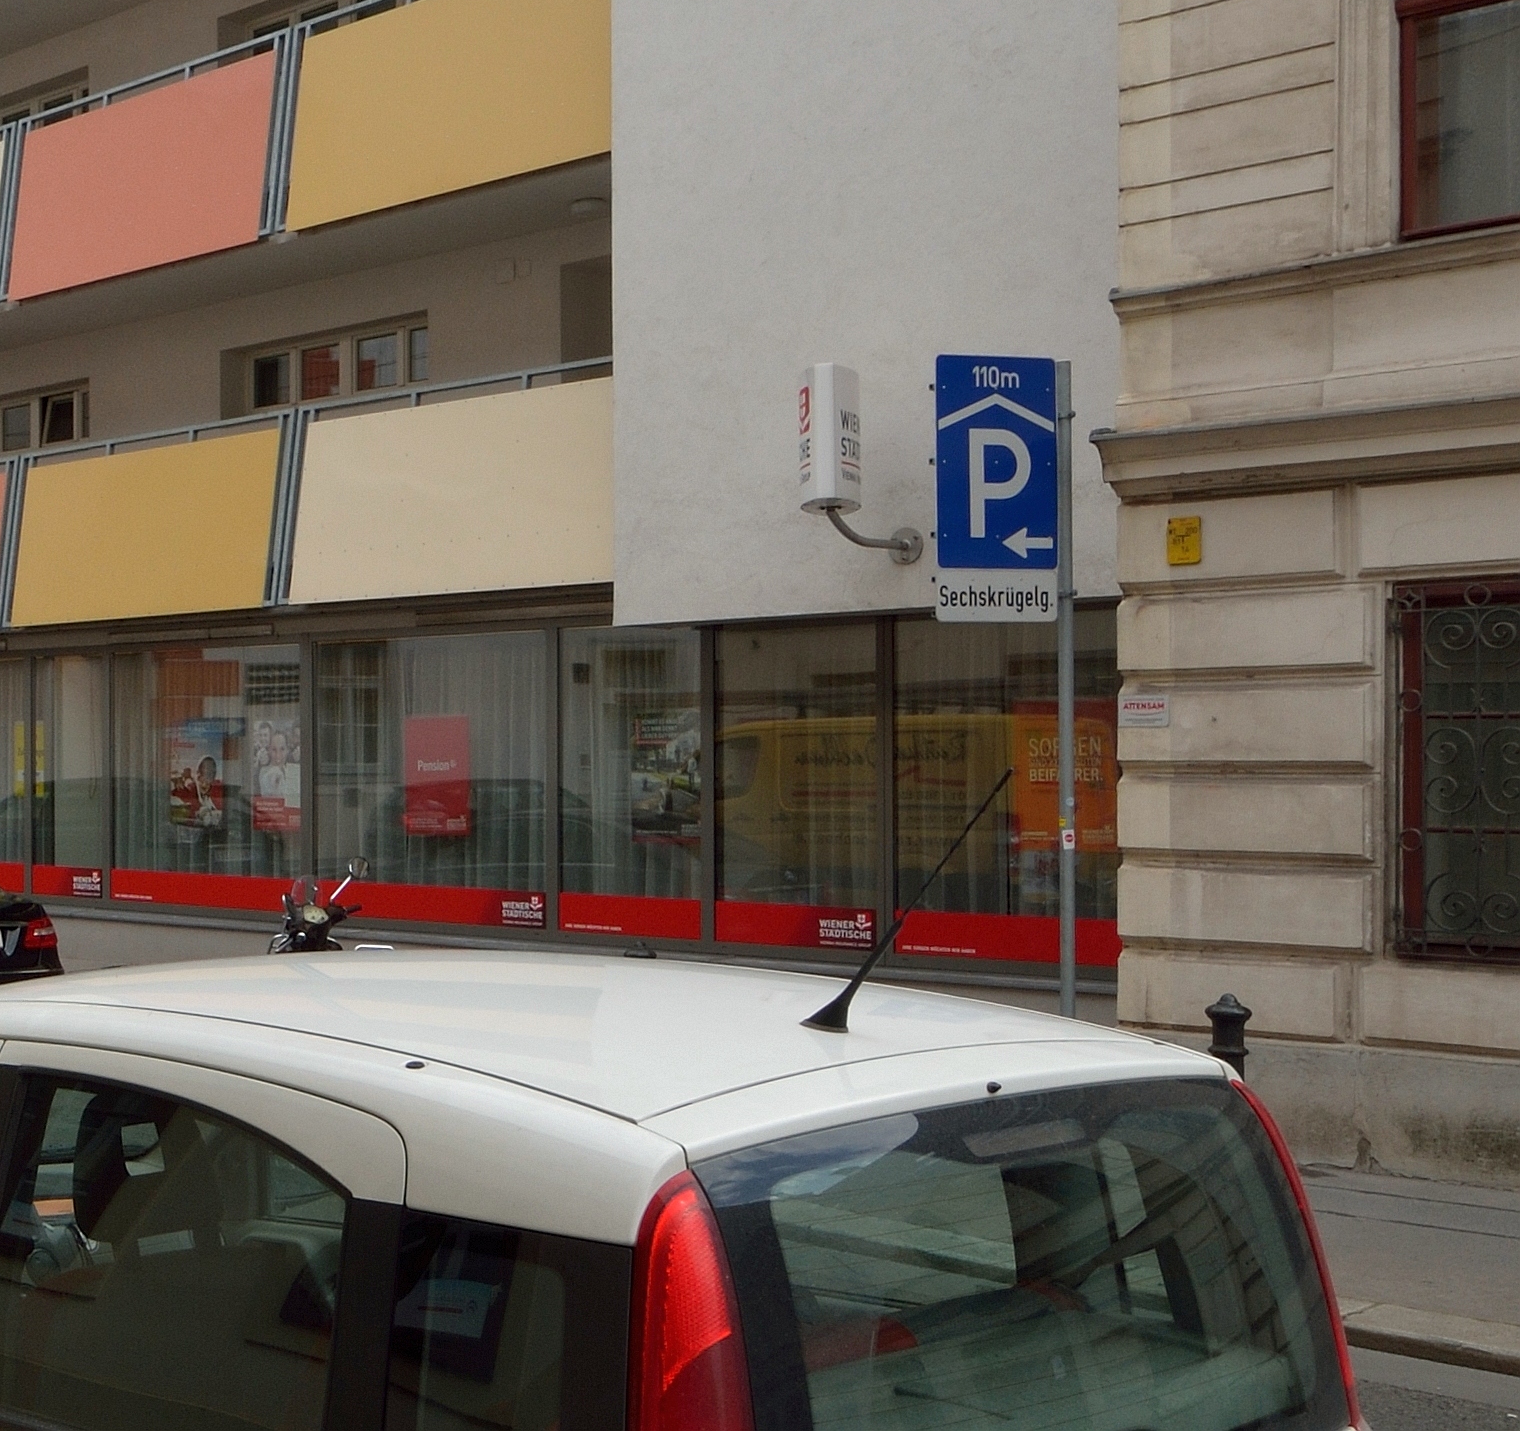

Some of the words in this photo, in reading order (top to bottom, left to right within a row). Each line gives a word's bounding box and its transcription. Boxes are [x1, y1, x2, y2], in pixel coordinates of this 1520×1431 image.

[972, 365, 1020, 389] 110m
[939, 585, 1054, 612] Sechskrügelg.
[1029, 736, 1101, 757] SOREN
[417, 759, 450, 771] Pension
[1029, 767, 1104, 782] BEIFRER.
[502, 901, 530, 910] WIENER
[818, 919, 855, 929] WIENER
